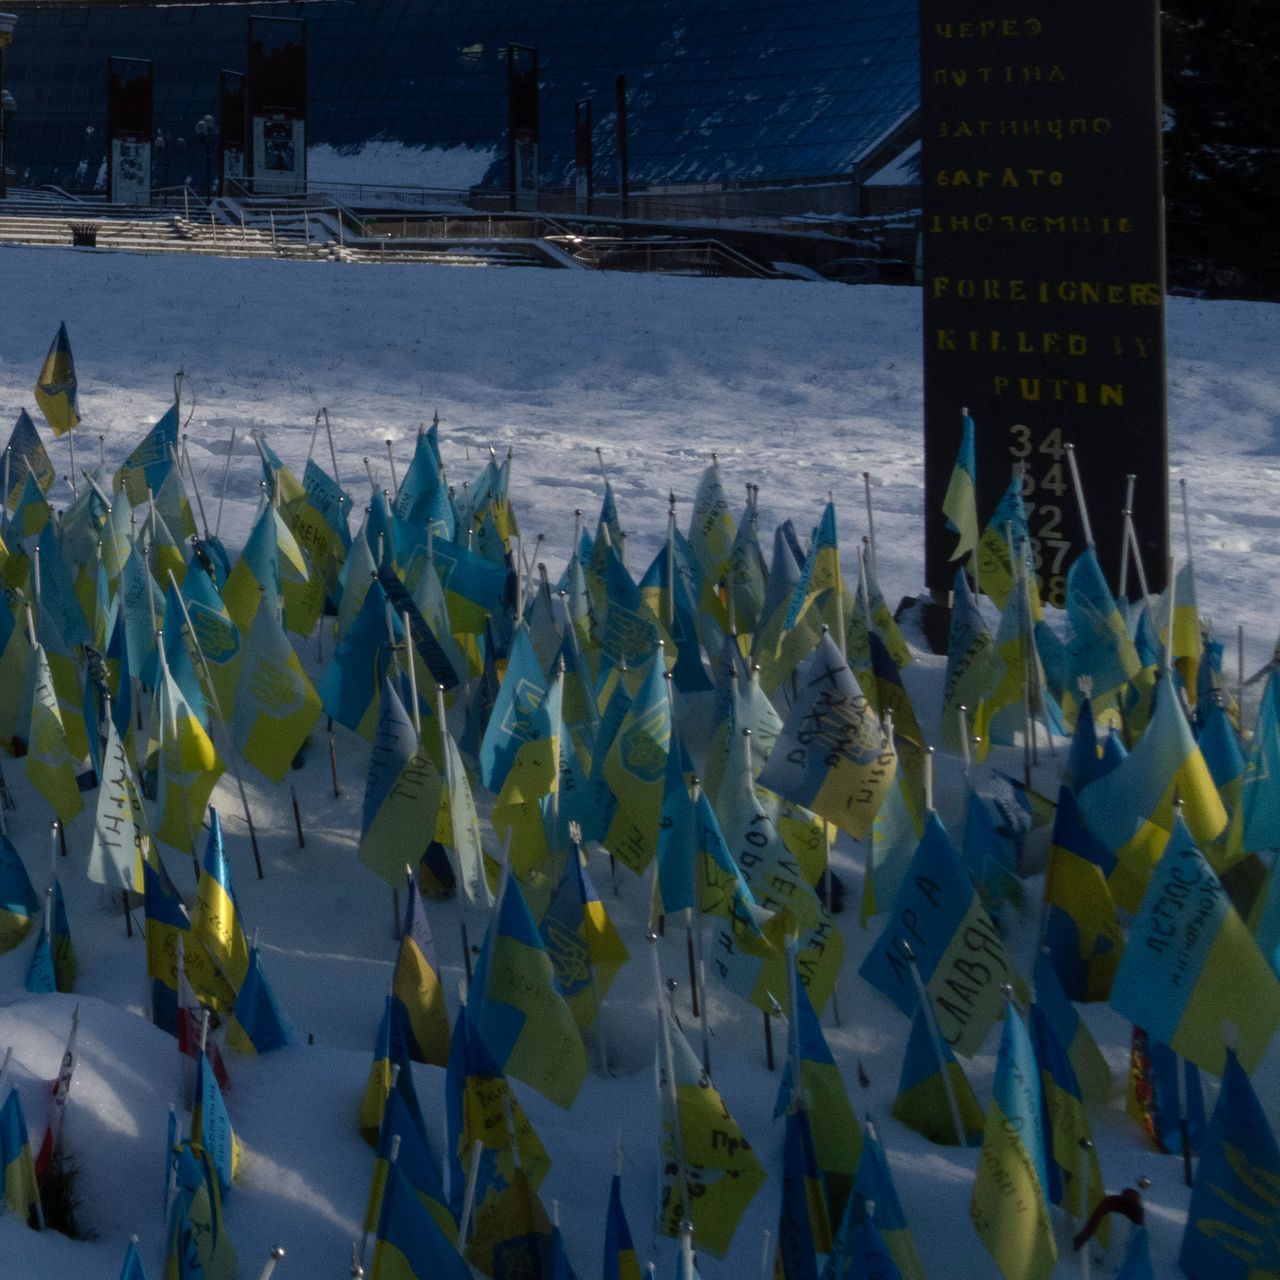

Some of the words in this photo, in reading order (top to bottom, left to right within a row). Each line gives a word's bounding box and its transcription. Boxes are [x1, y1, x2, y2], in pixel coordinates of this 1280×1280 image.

[933, 276, 1162, 306] FOREIGNERS
[937, 329, 1088, 355] KILLED
[994, 376, 1125, 407] PUTIN
[1008, 424, 1065, 460] 34
